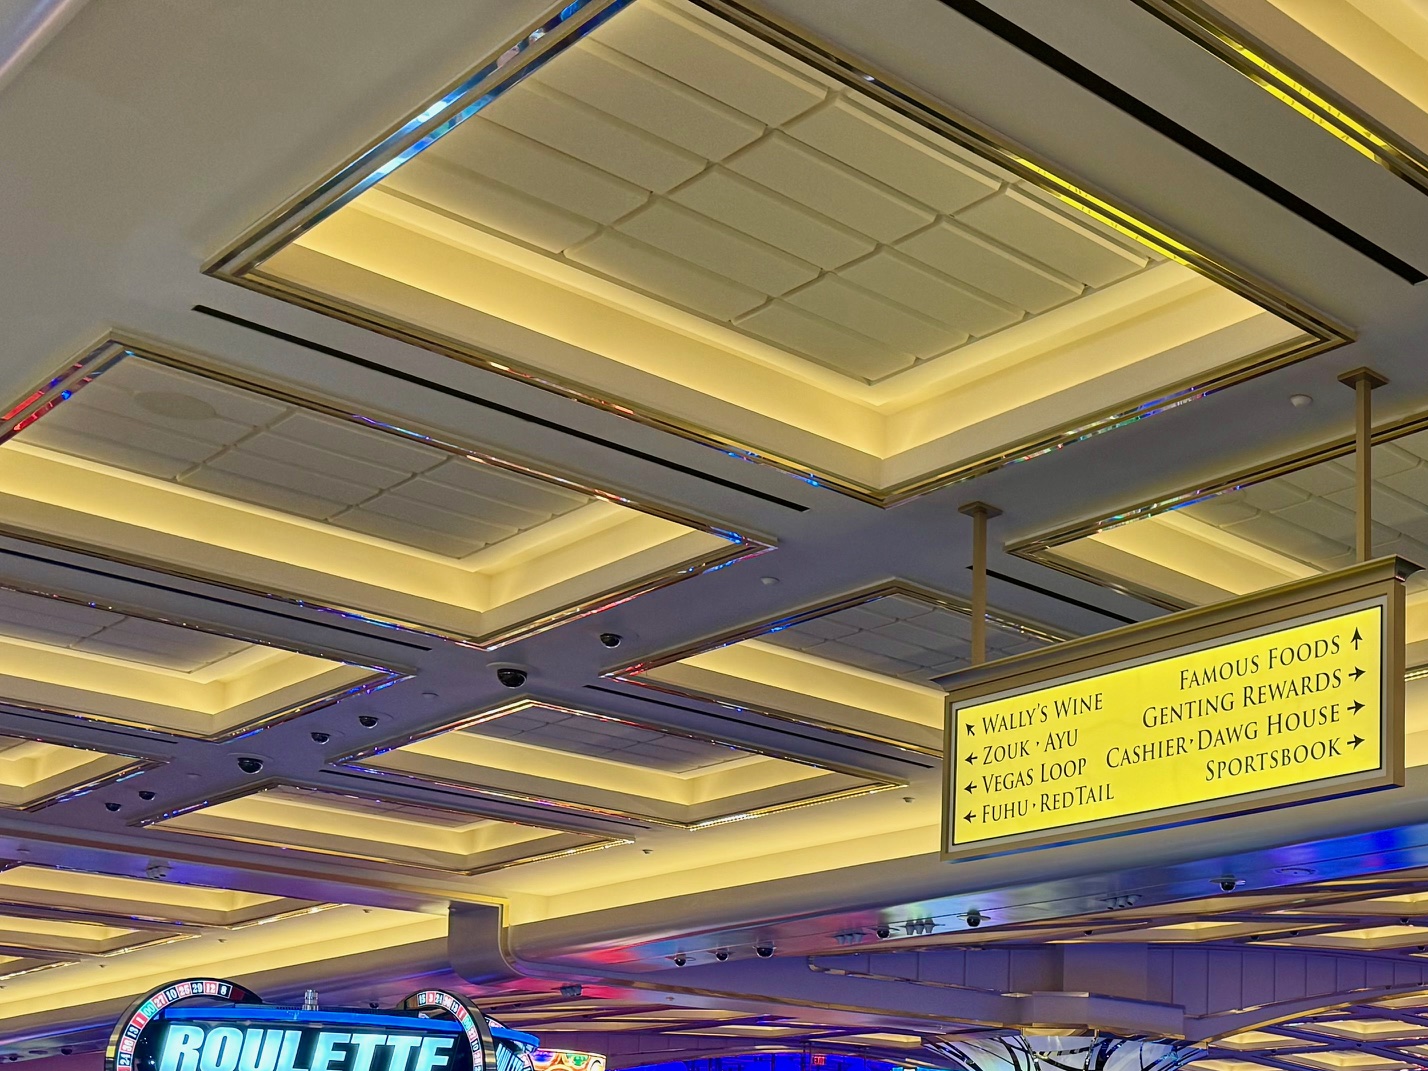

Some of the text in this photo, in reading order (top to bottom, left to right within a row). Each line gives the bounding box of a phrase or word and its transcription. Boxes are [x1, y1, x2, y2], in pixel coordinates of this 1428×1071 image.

[1180, 635, 1340, 690] FAMOUS FOODS
[983, 693, 1103, 734] WALLY'S WINE
[1143, 668, 1342, 728] GENTING REWARDS
[983, 729, 1078, 765] ZOUK AYU
[1198, 721, 1258, 751] DAWG
[1267, 703, 1340, 736] HOUSE
[982, 758, 1087, 794] VEGAS LOOP
[1206, 737, 1342, 782] SPORTSBOOK
[982, 800, 1029, 823] FUHU
